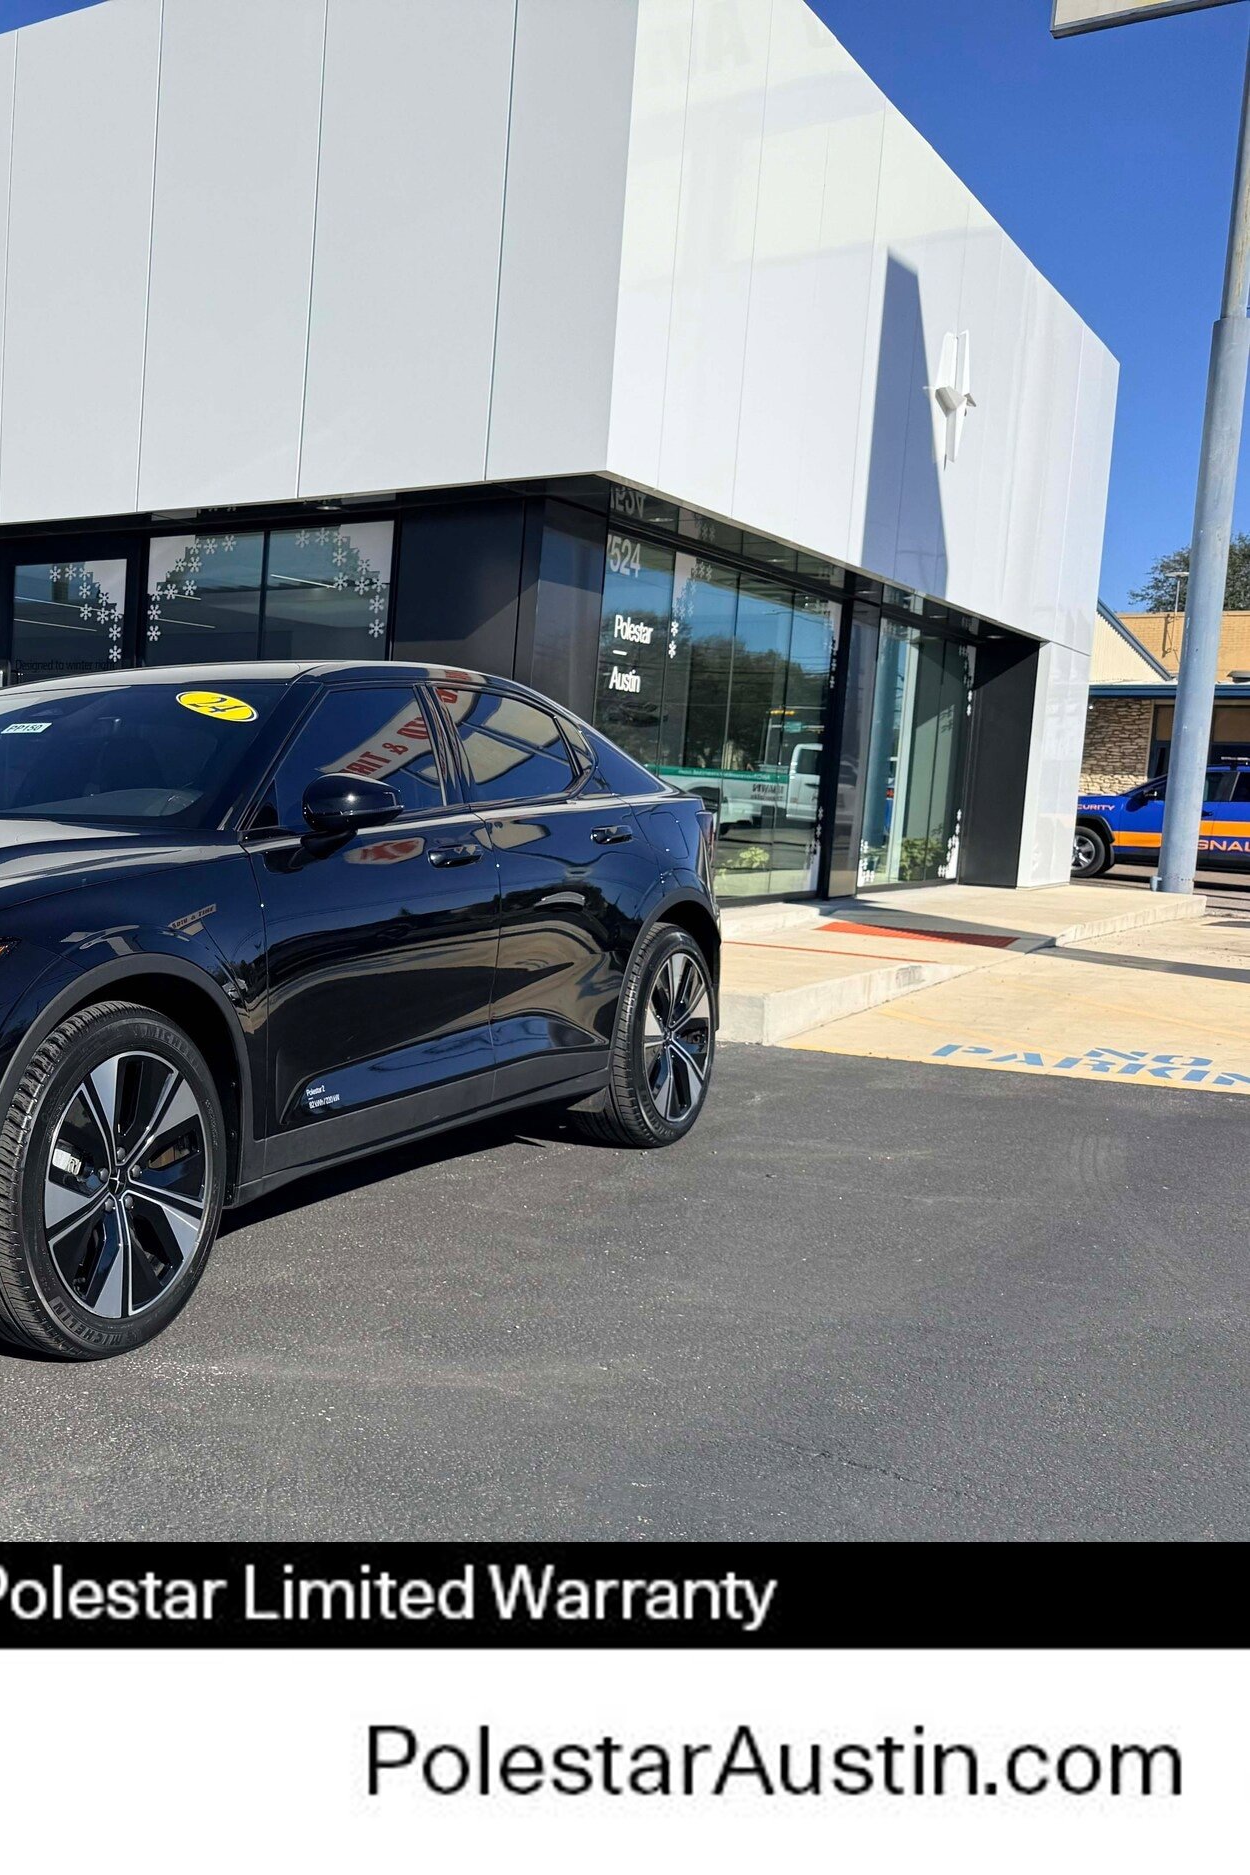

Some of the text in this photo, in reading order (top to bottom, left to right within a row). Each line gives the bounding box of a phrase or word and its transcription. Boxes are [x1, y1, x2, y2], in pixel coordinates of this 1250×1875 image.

[614, 614, 654, 645] Polestar
[608, 665, 641, 693] Austin
[931, 1044, 1250, 1086] PARKIN
[1085, 1047, 1213, 1067] NO
[52, 1300, 123, 1346] MICHELIN
